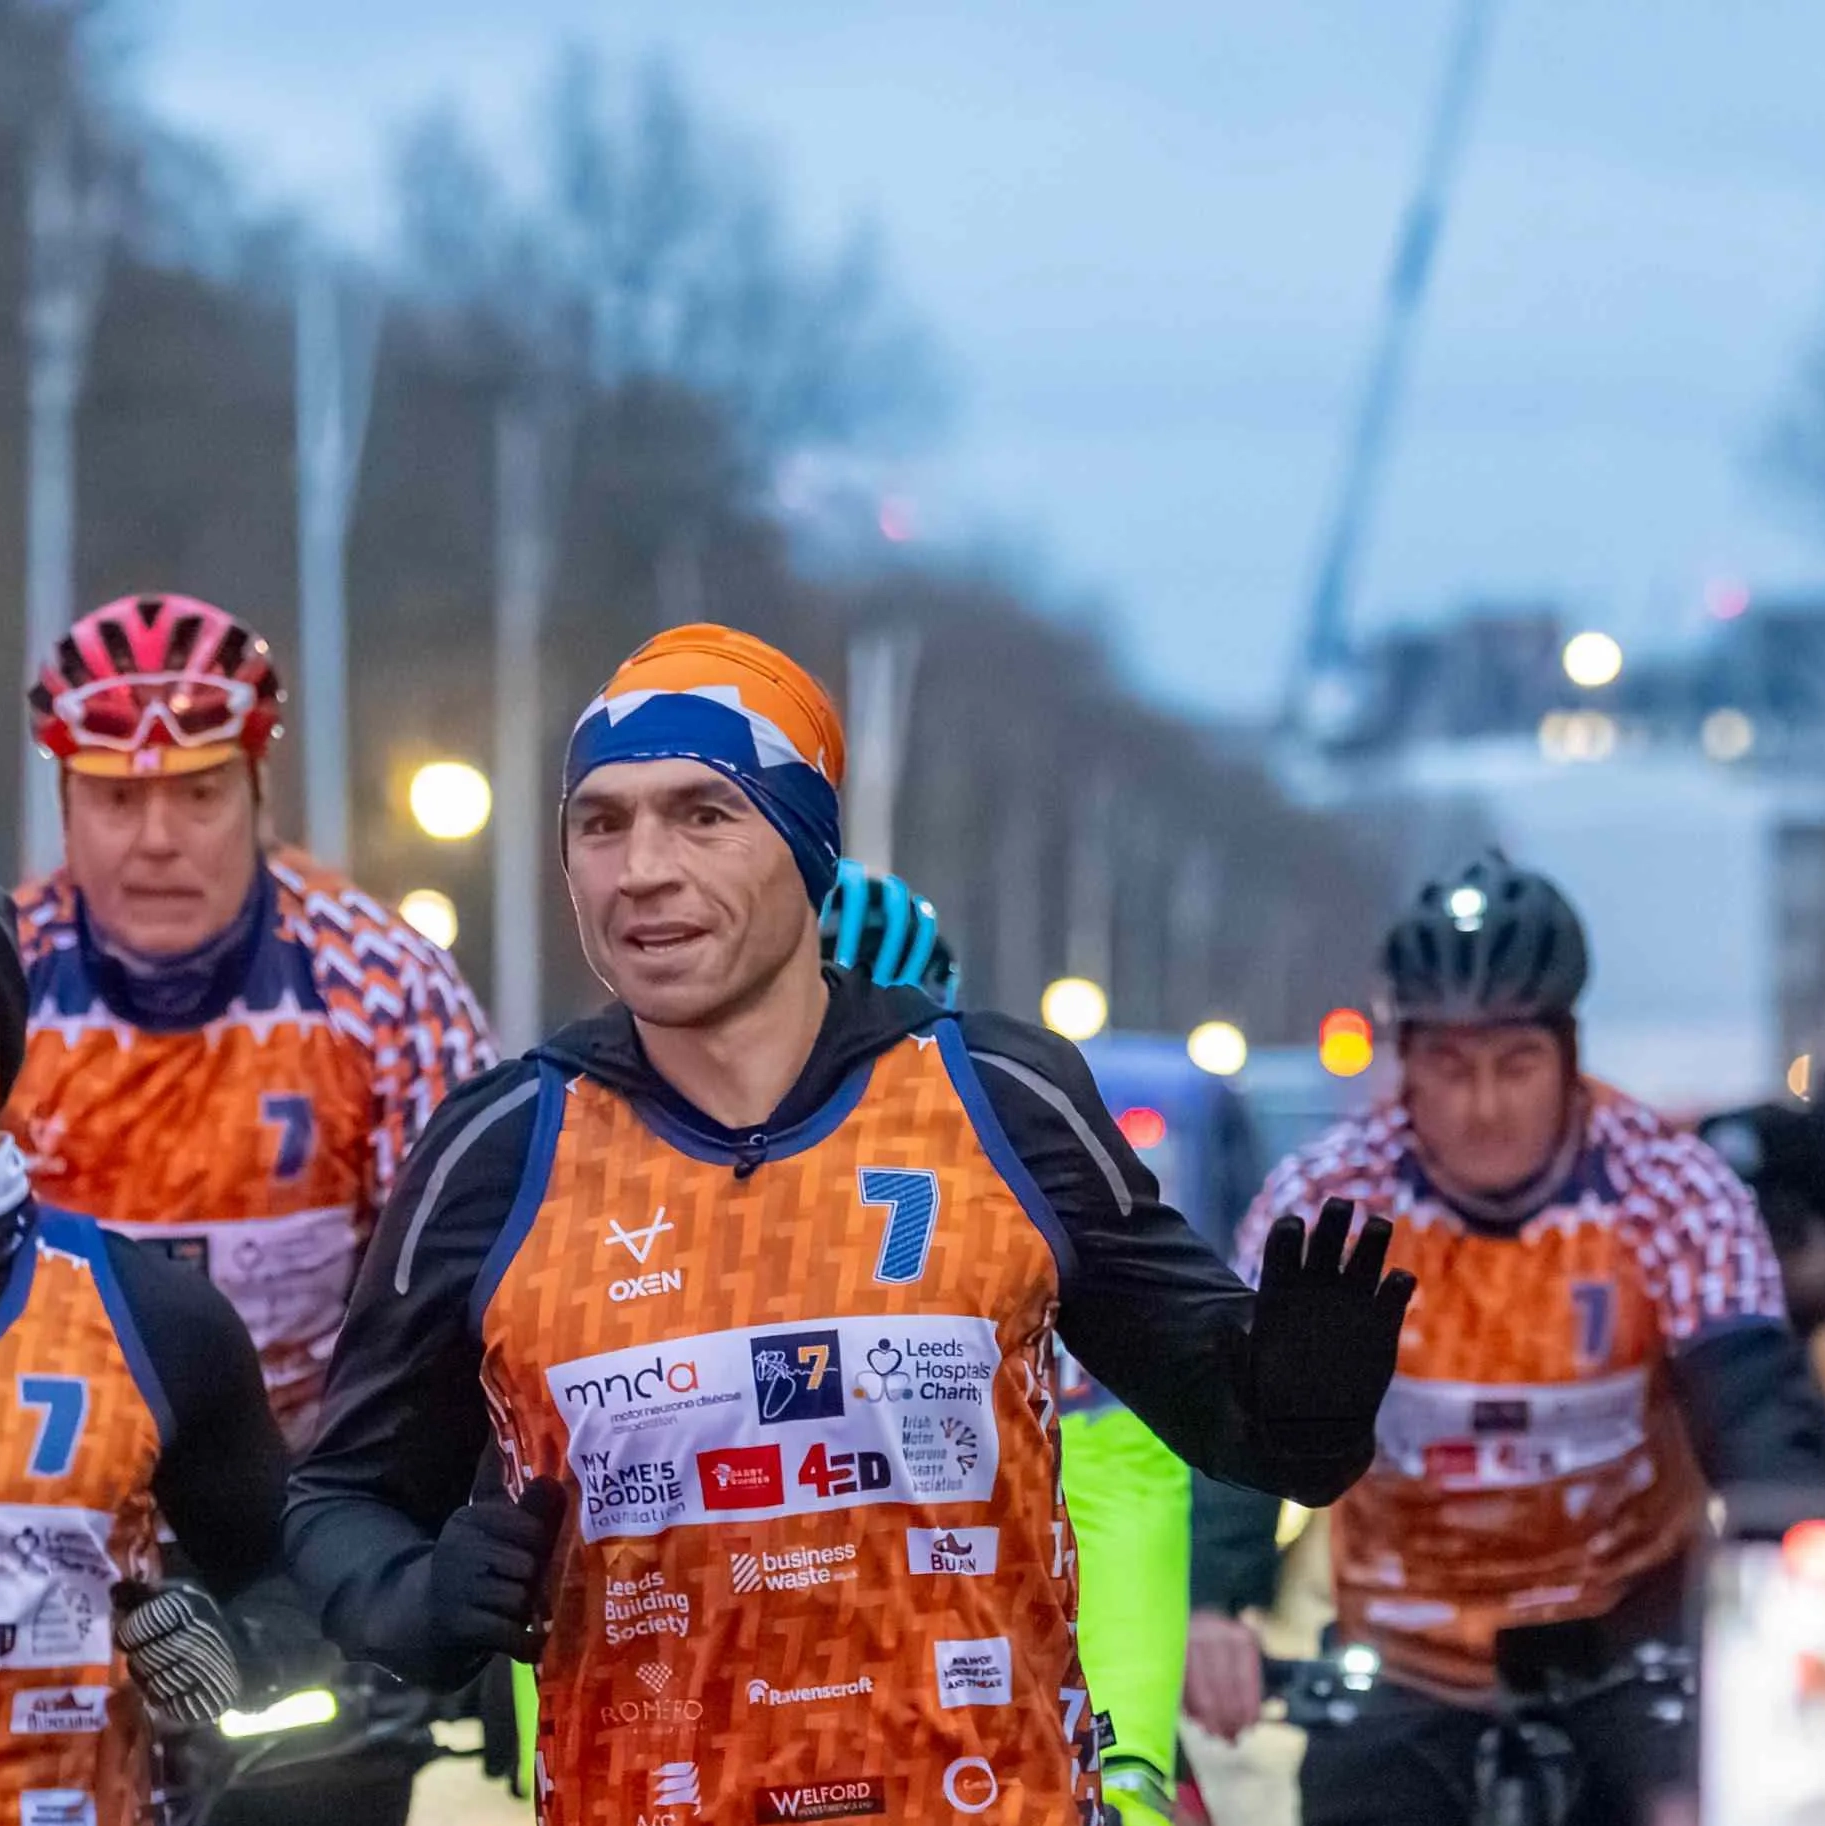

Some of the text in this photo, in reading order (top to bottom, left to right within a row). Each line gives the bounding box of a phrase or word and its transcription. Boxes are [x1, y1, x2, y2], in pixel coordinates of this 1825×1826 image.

[856, 1166, 941, 1285] 7
[608, 1268, 682, 1302] OXEN
[906, 1338, 964, 1358] Leeds
[797, 1344, 830, 1390] 7
[564, 1357, 699, 1408] mnda
[920, 1382, 983, 1405] Charity
[17, 1373, 89, 1478] 7
[580, 1450, 610, 1472] MY
[587, 1481, 684, 1516] DODDIE
[762, 1543, 857, 1572] business
[606, 1572, 665, 1596] Leeds
[765, 1566, 831, 1591] waste
[606, 1590, 689, 1620] Building
[606, 1614, 689, 1645] Society
[770, 1676, 873, 1706] Ravenscroft
[769, 1782, 871, 1817] WELFORD
